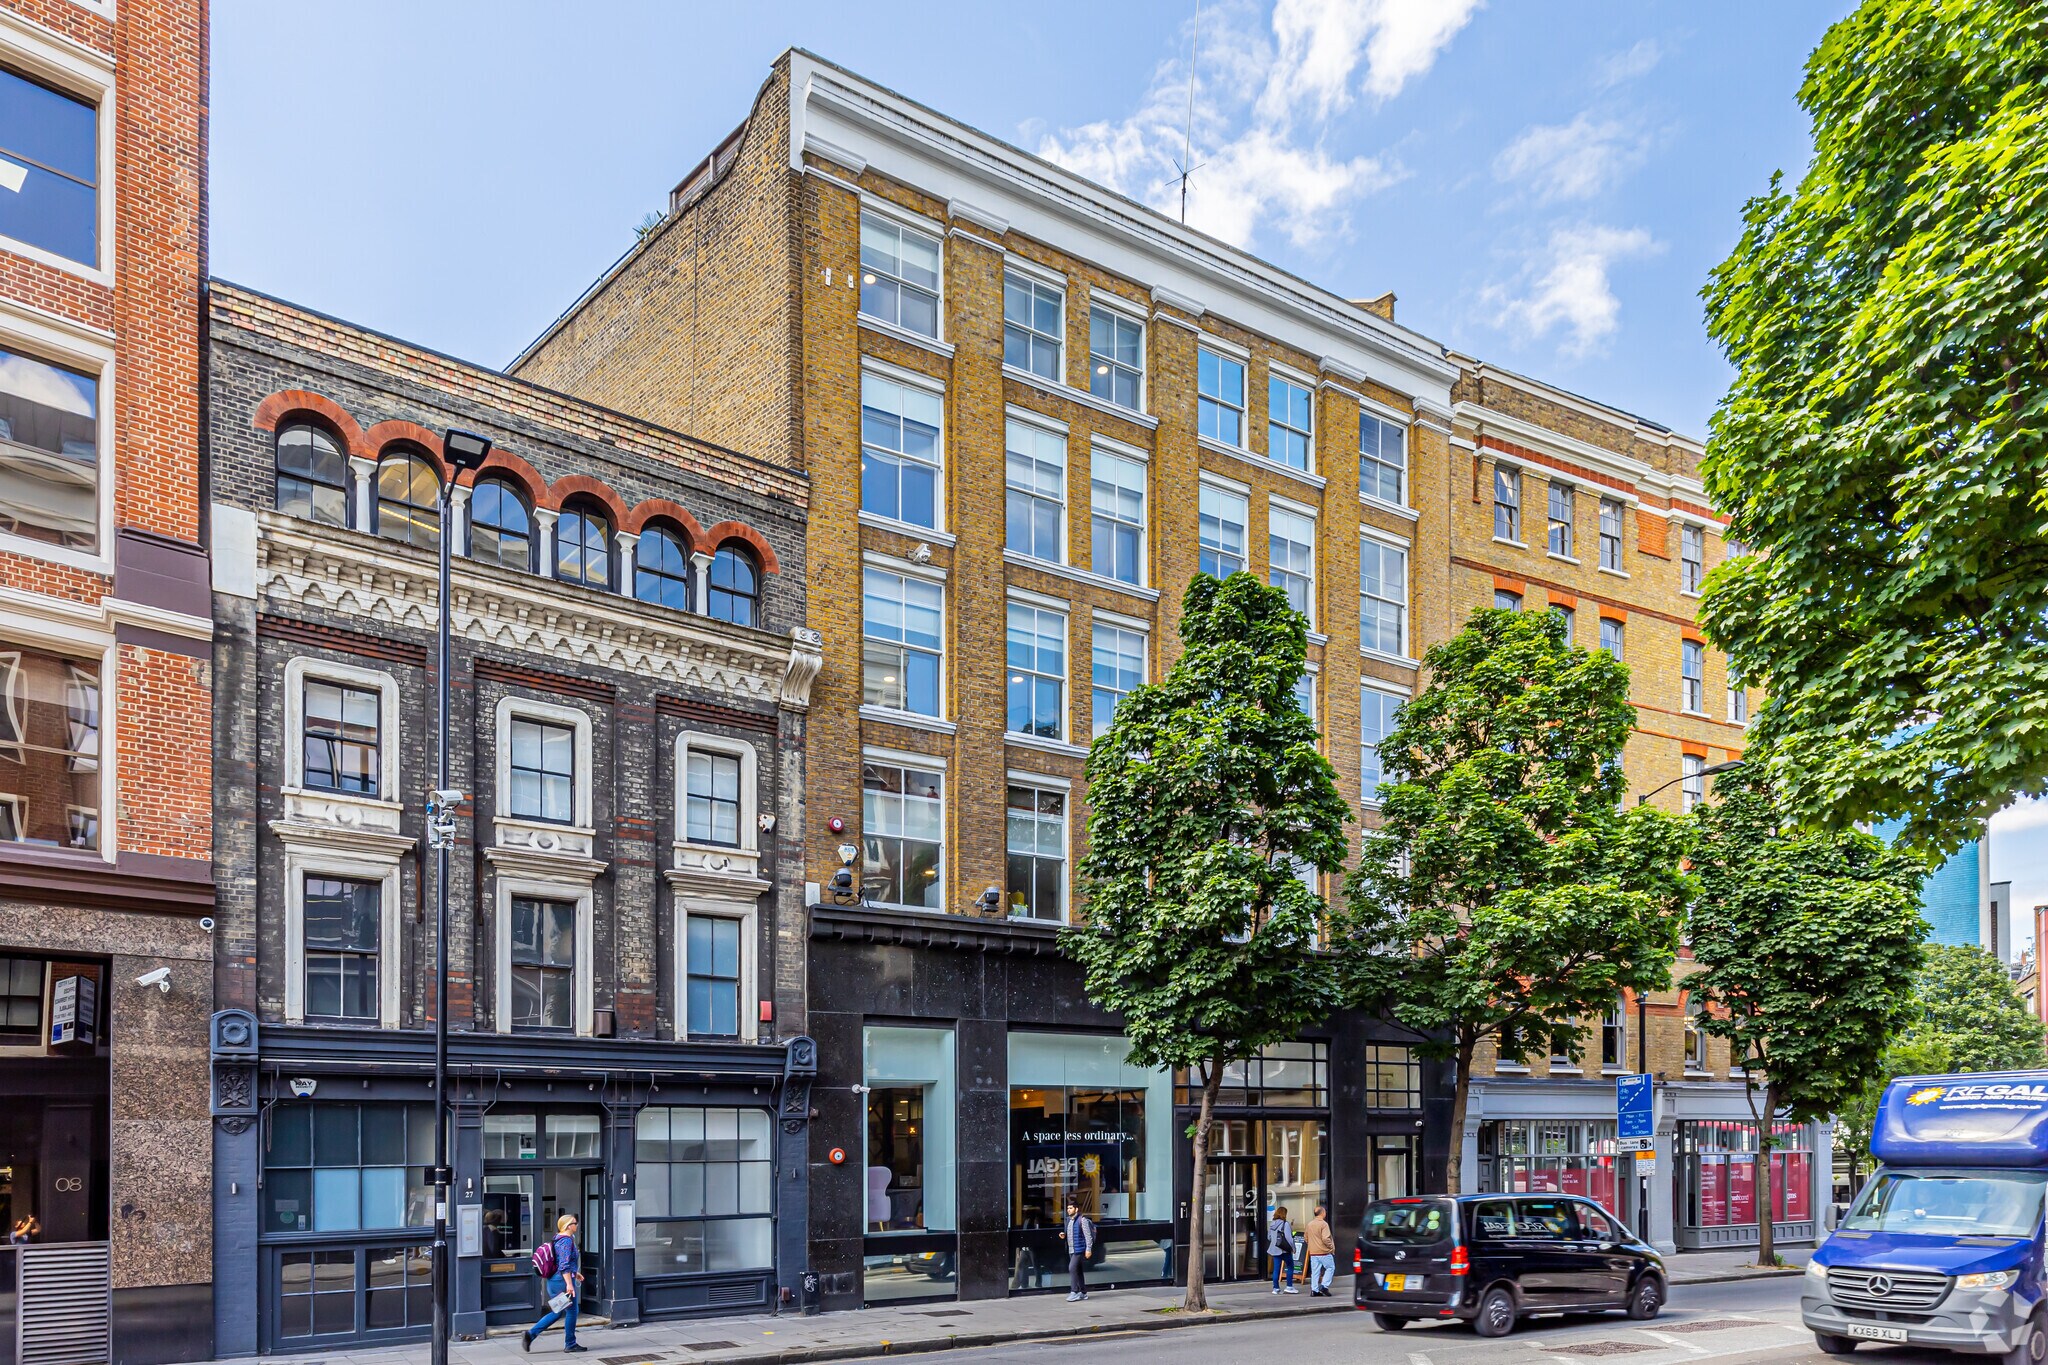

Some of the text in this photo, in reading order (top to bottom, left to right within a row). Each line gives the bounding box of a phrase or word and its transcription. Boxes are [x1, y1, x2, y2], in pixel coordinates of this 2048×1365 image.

[1946, 1084, 2048, 1097] REGAL
[1022, 1130, 1134, 1143] A space less ordinary...
[1853, 1326, 1902, 1340] KX68 XLJ
